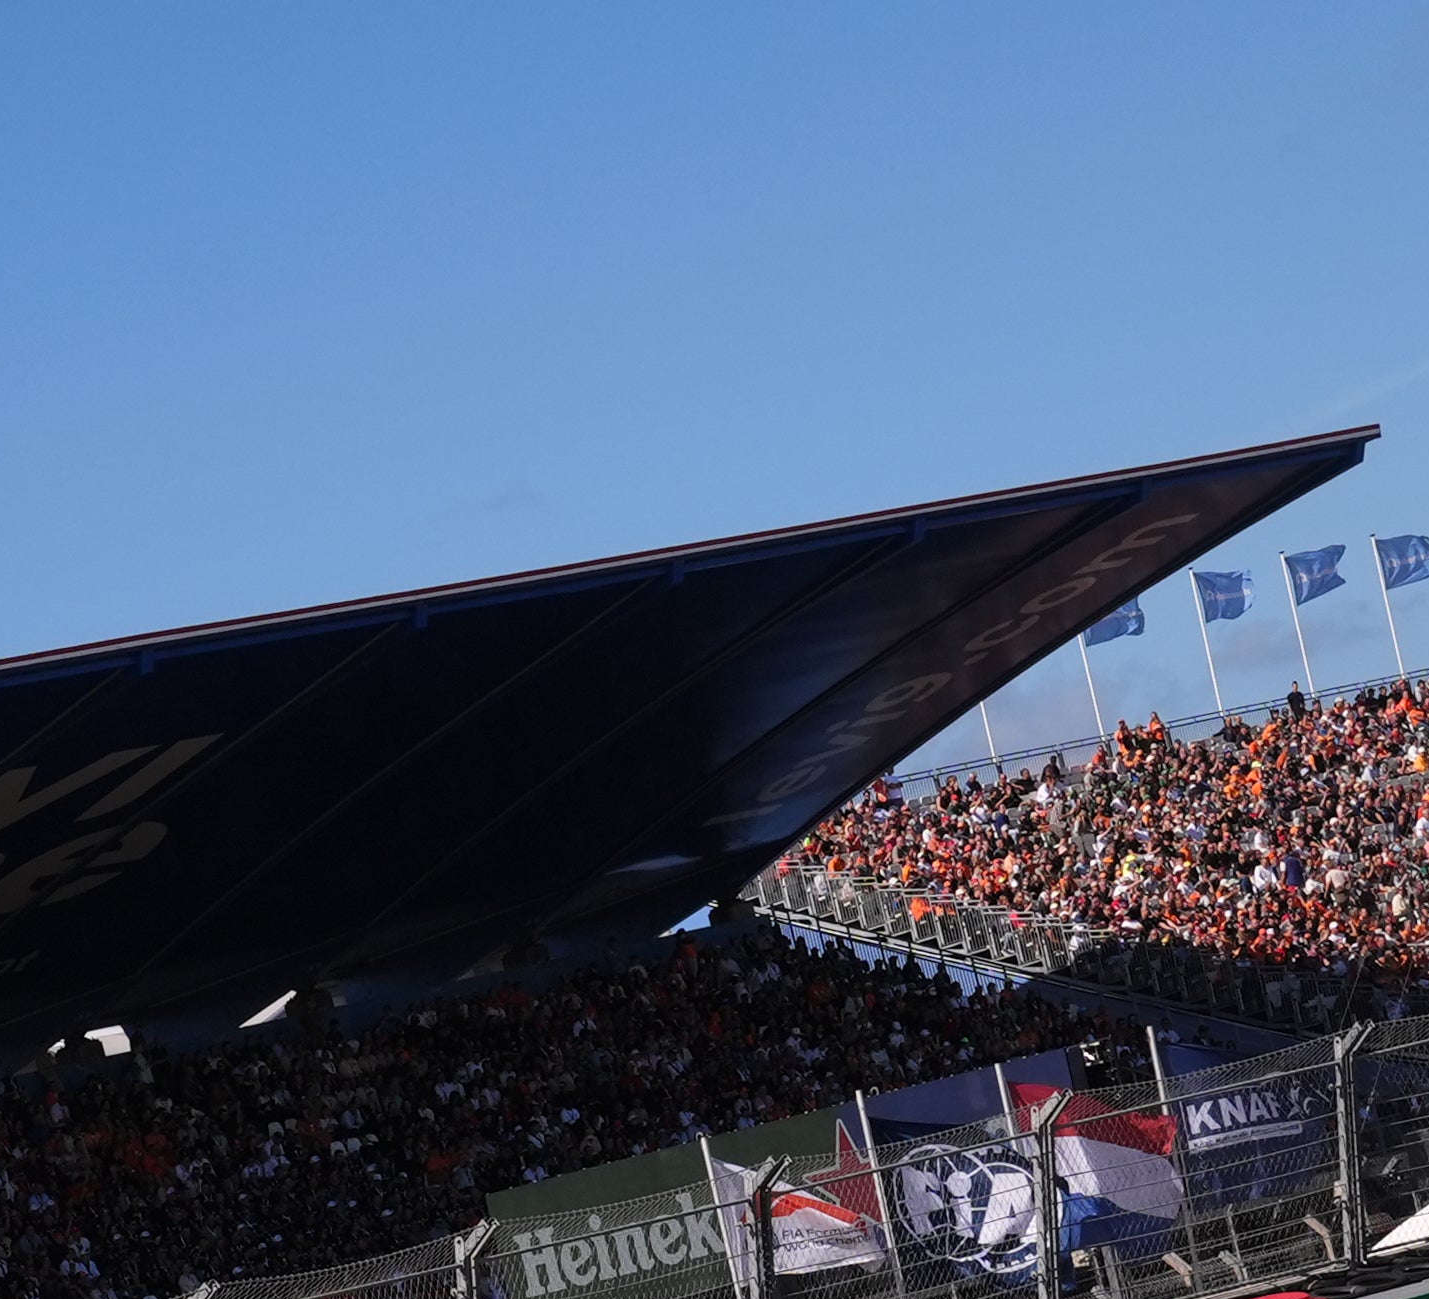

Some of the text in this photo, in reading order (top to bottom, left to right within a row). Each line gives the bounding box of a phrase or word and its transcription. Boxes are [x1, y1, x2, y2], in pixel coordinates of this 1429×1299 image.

[1186, 1091, 1283, 1135] KNAF
[900, 1164, 1034, 1246] FIA
[782, 1228, 804, 1240] FIA
